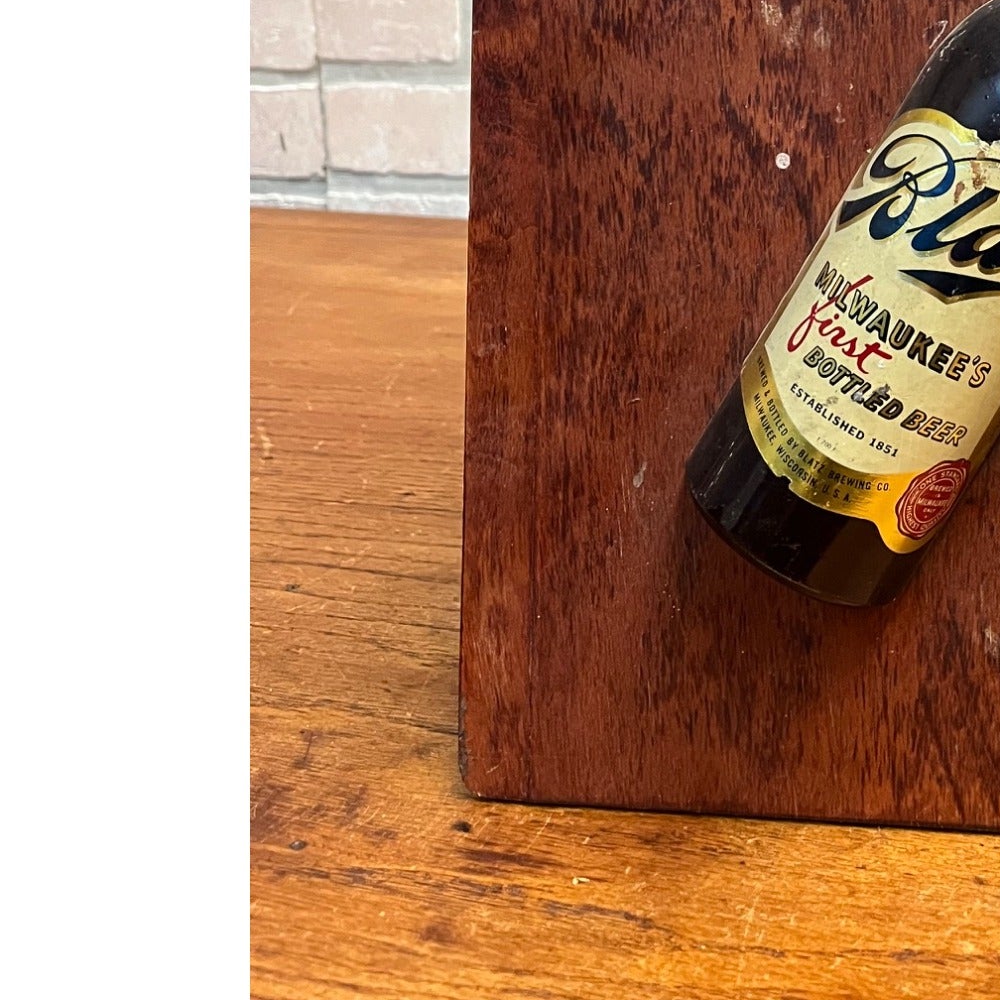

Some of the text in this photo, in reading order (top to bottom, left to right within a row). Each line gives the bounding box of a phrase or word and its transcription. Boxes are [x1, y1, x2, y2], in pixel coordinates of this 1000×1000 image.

[787, 275, 893, 374] first
[814, 261, 992, 388] MILWAUKEE'S
[789, 383, 899, 458] ESTABLISHED 1851
[803, 345, 968, 447] BOTTLED BEER
[766, 399, 788, 437] BOTTLED
[786, 437, 799, 450] BY
[797, 448, 826, 475] BLATZ
[826, 469, 872, 491] BREWING
[919, 475, 937, 490] ONE
